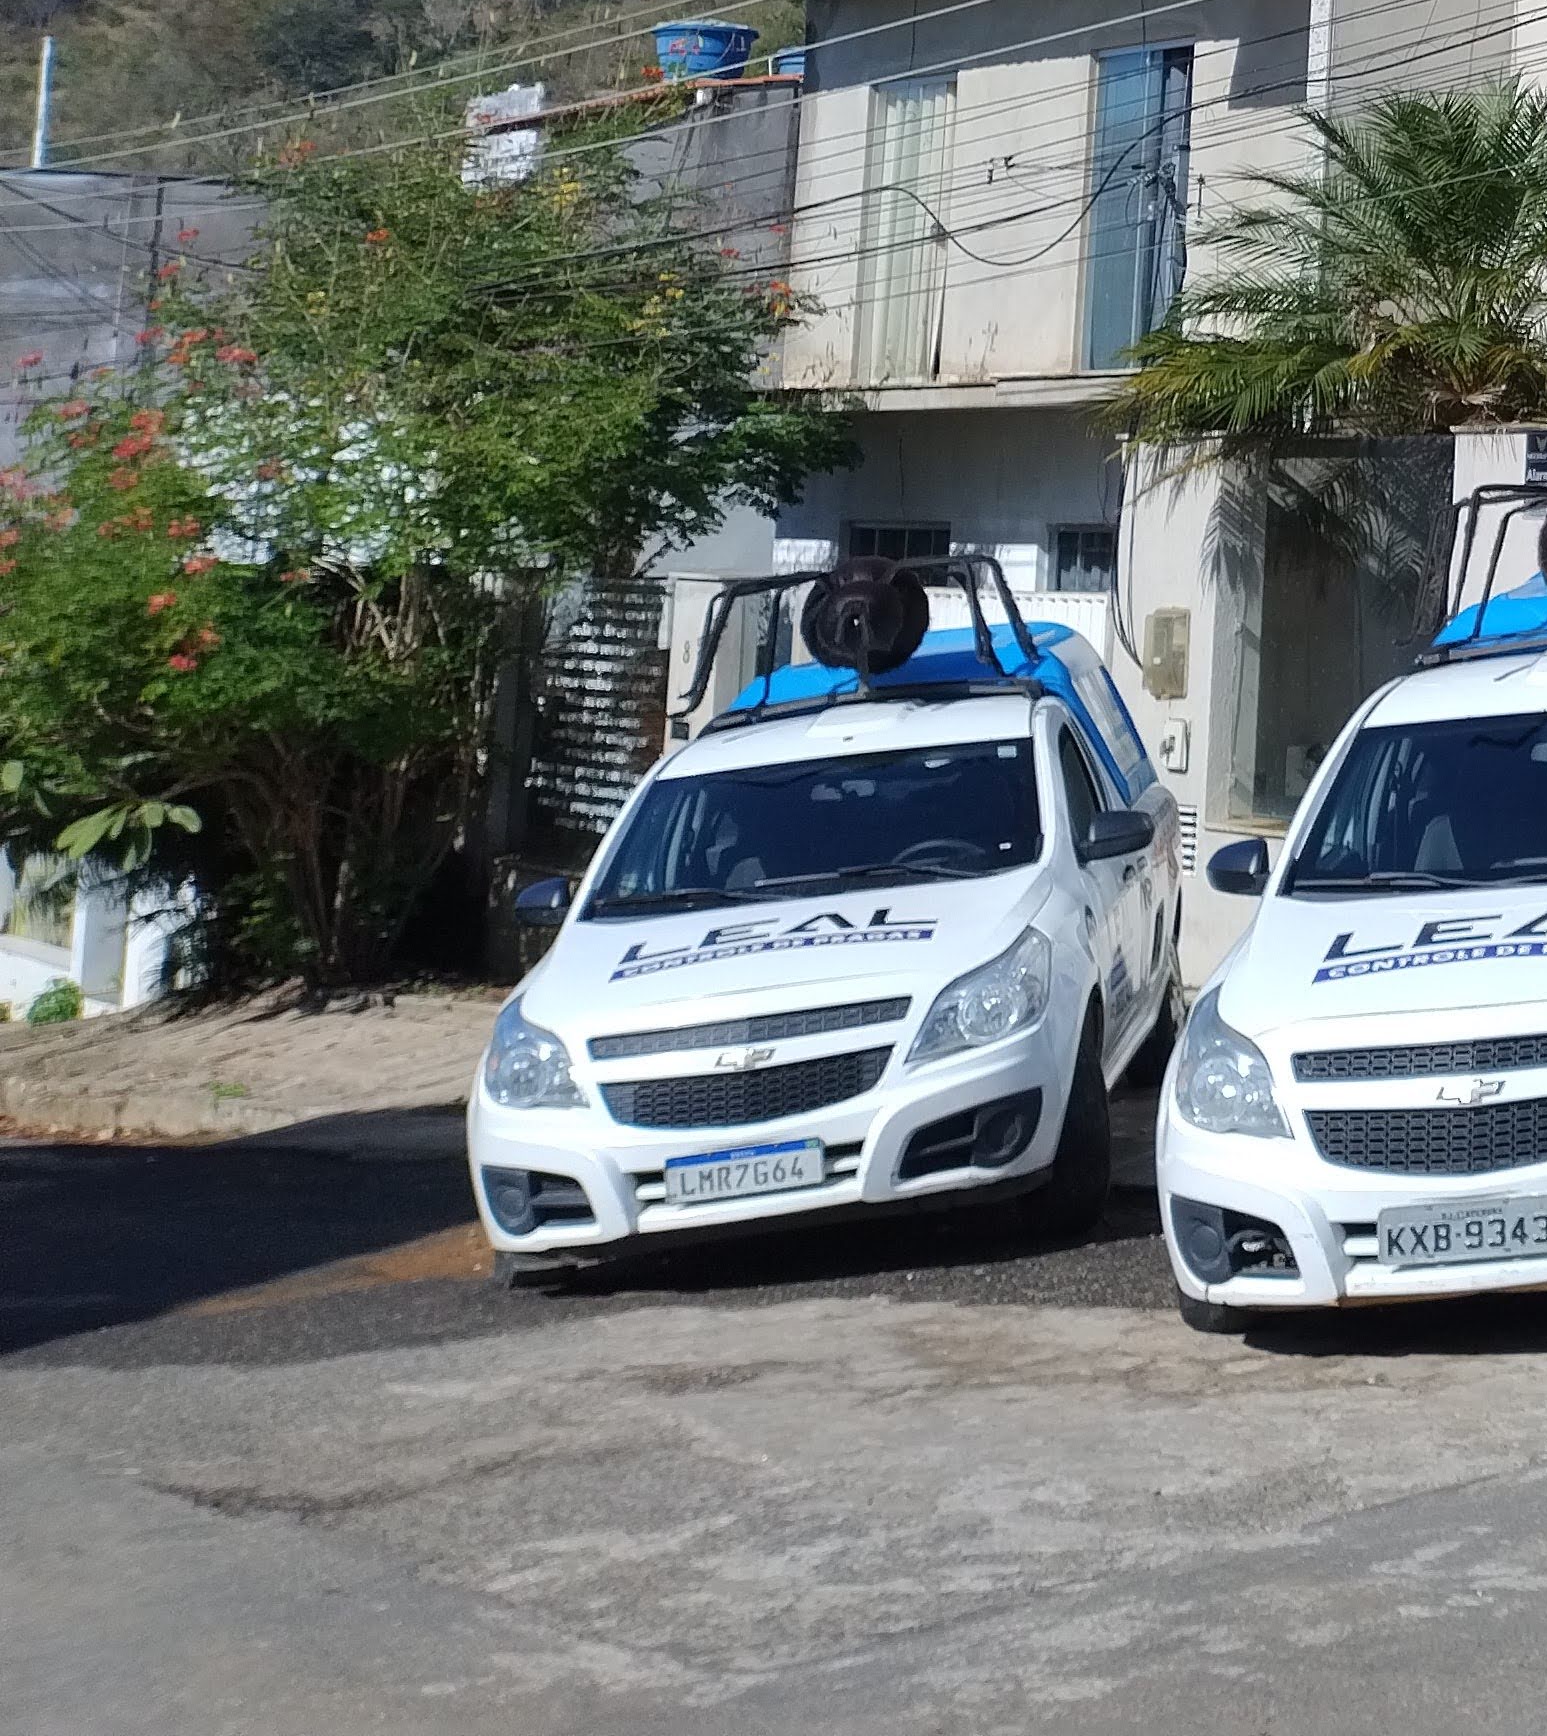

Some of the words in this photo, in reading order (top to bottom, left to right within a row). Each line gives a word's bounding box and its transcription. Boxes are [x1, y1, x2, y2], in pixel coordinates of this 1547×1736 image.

[618, 907, 938, 964] LEAL
[1328, 946, 1486, 980] CONTROLE
[1496, 944, 1532, 956] DE
[679, 1156, 804, 1196] LMR7G64
